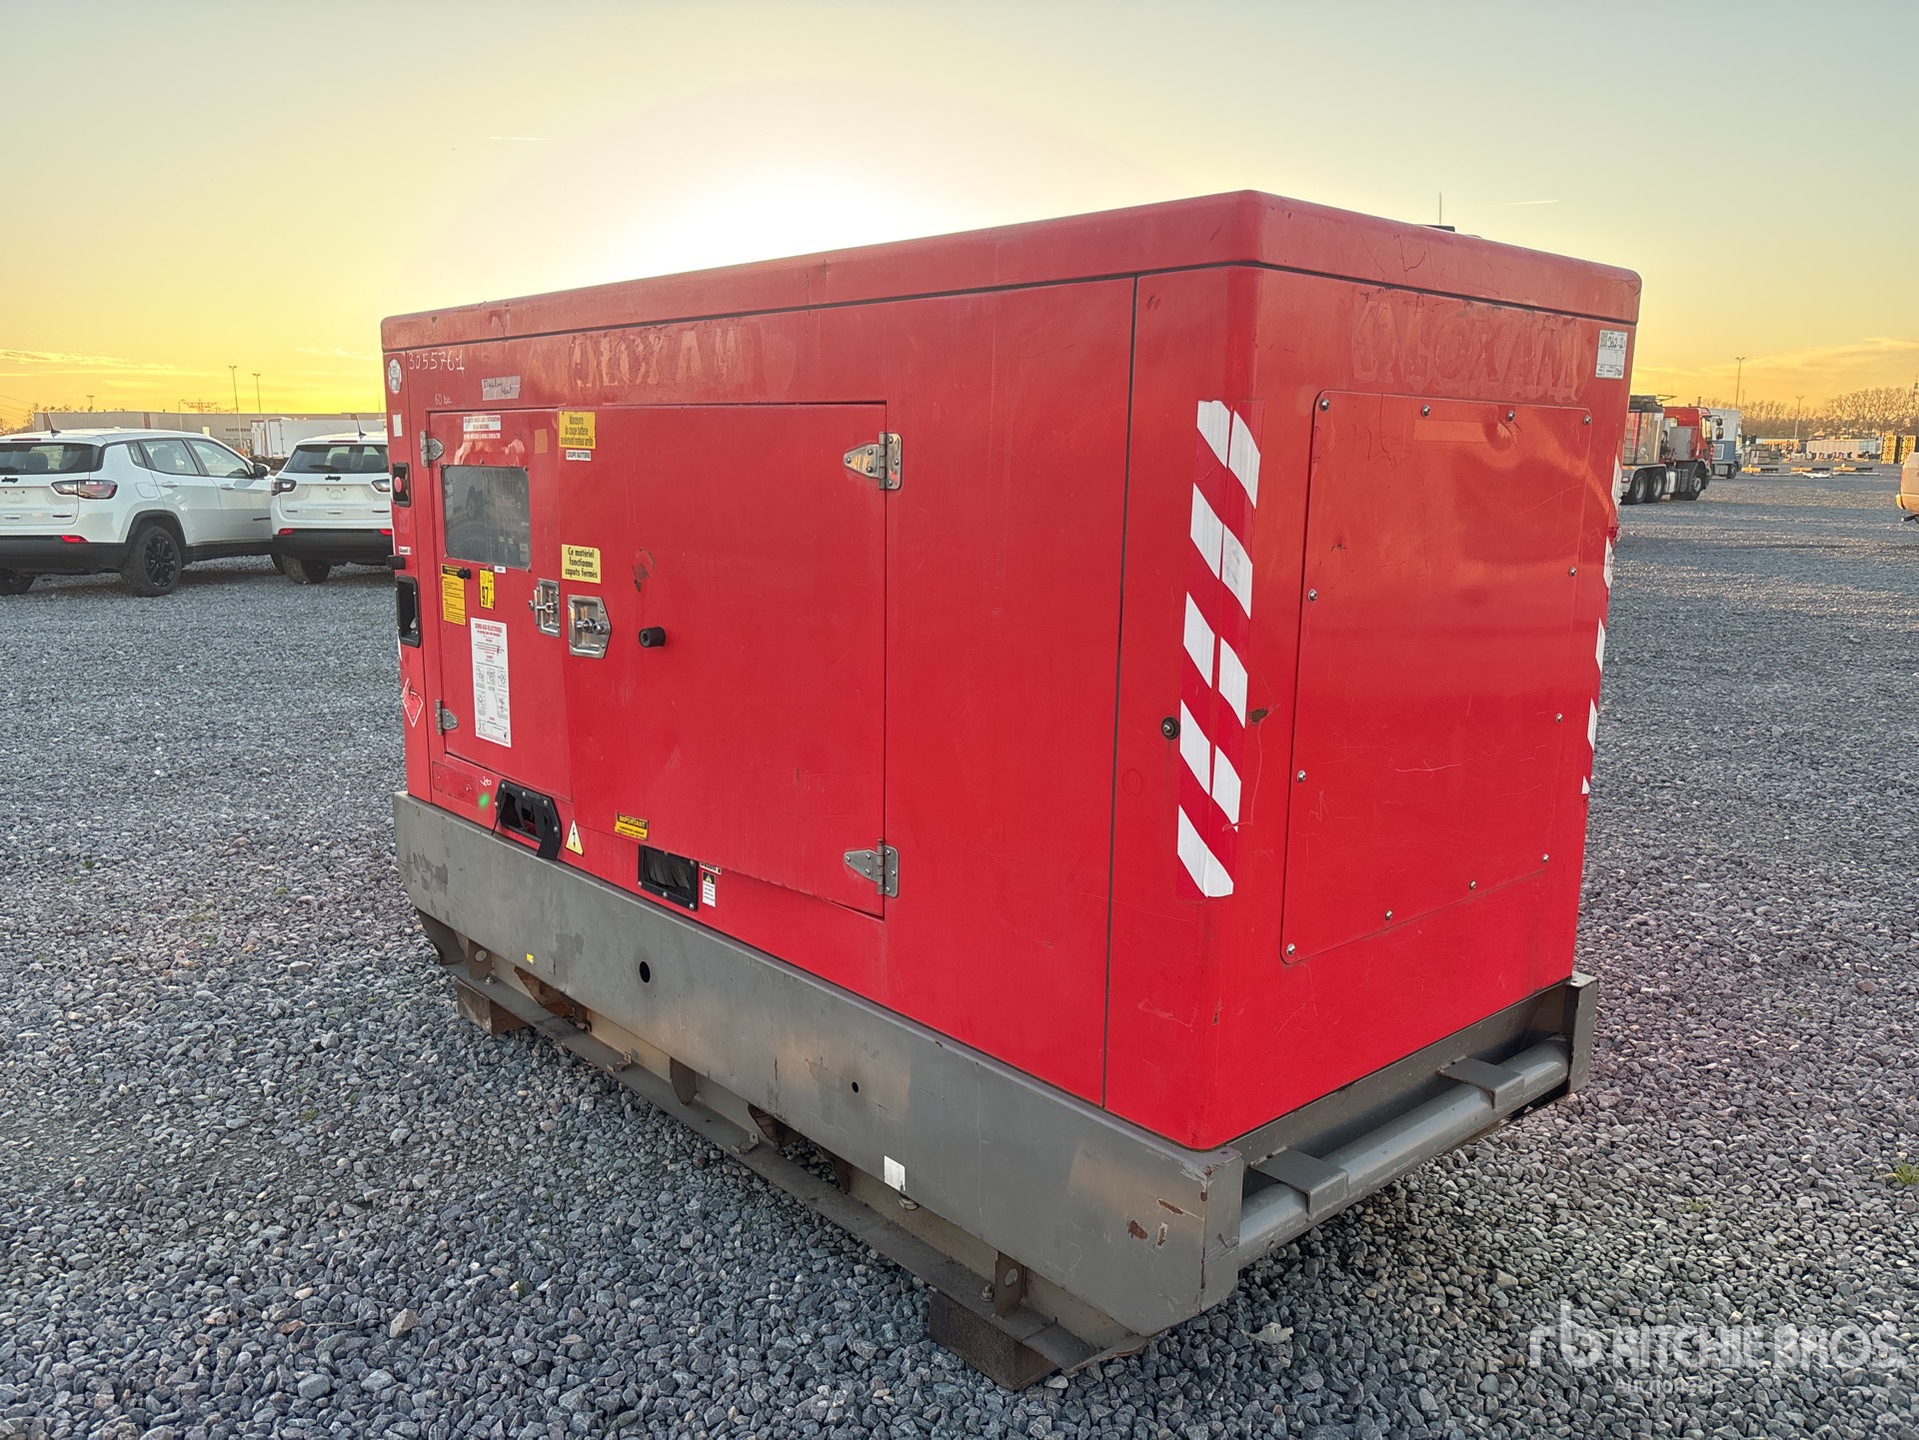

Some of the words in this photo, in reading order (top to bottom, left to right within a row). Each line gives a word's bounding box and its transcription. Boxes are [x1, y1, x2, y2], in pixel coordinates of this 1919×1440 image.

[568, 547, 574, 556] Ce
[575, 549, 595, 558] matériel
[569, 556, 593, 568] fonctionne
[565, 568, 580, 578] capots
[581, 567, 598, 579] fermés
[619, 815, 645, 828] IMPORTANT
